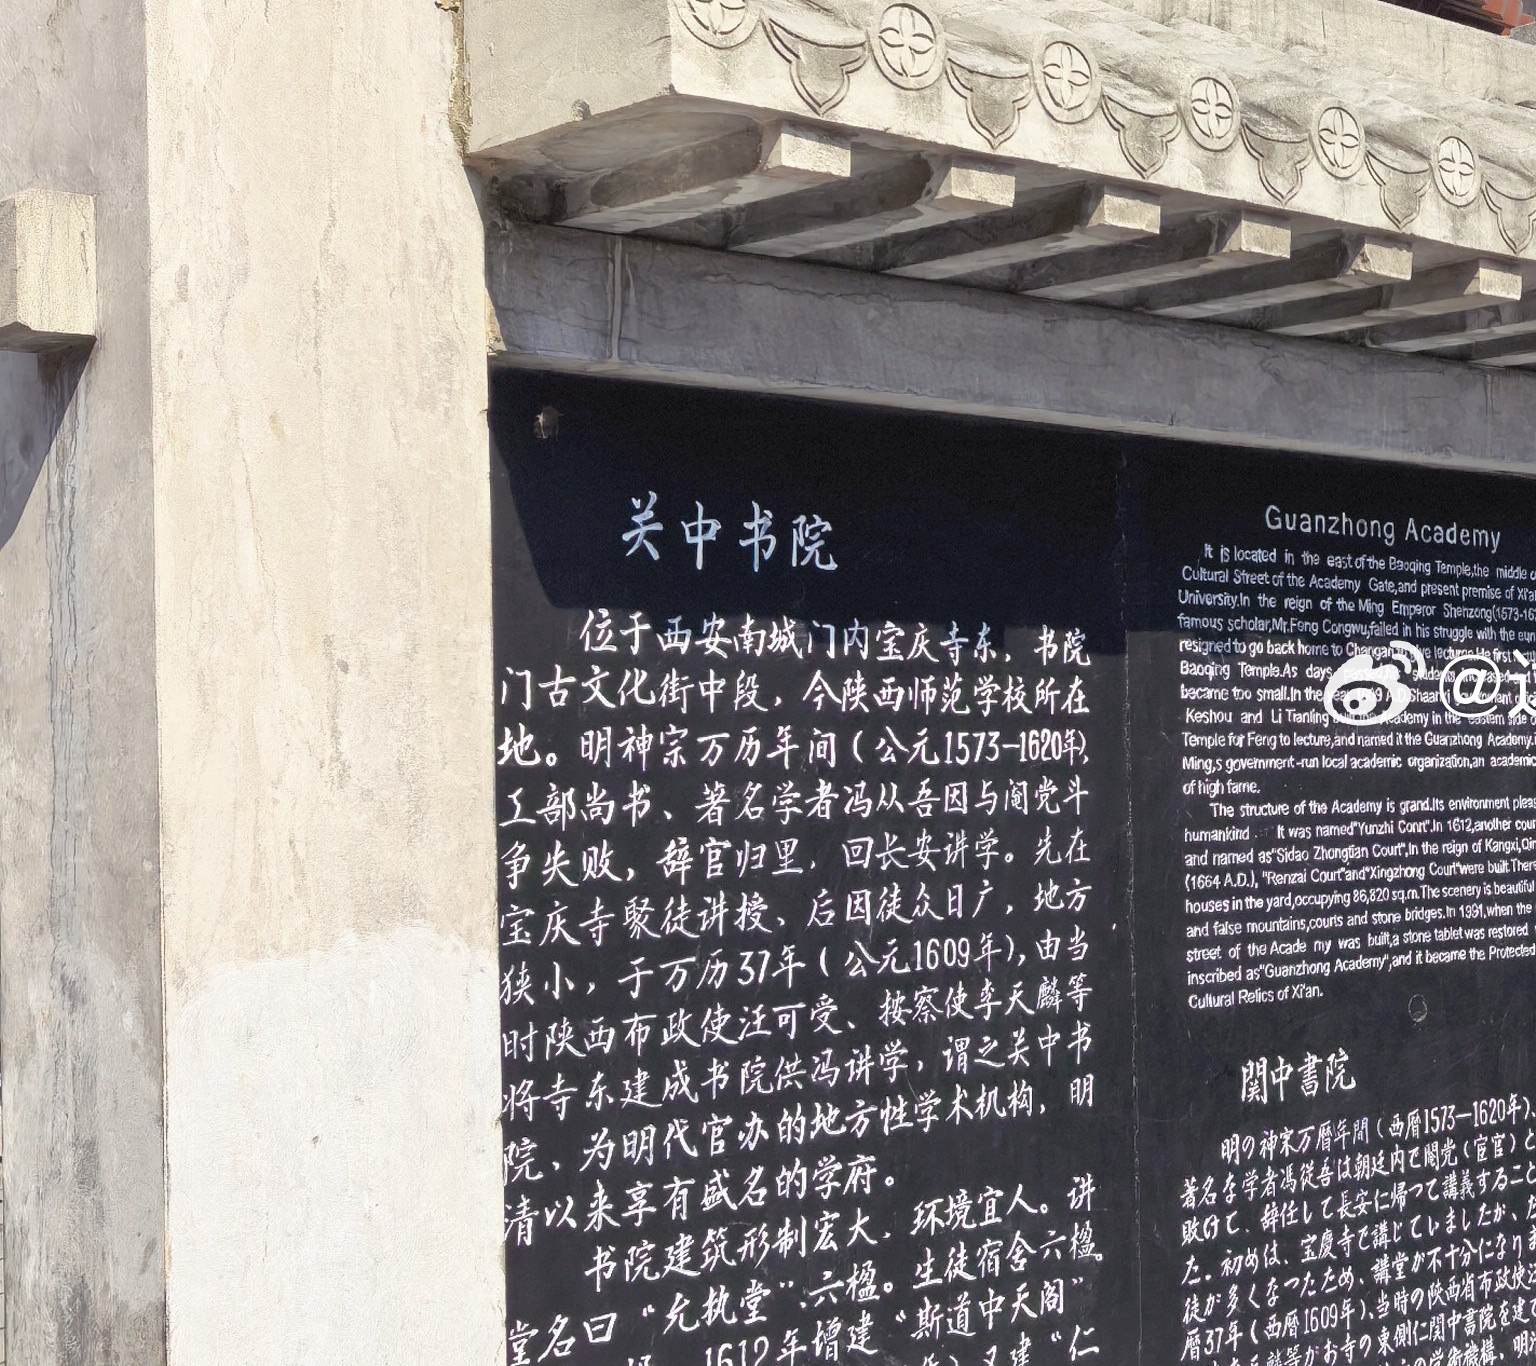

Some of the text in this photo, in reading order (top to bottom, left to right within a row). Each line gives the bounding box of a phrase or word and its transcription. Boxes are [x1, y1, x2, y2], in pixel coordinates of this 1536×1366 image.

[622, 491, 838, 572] 关中书院
[1266, 506, 1500, 553] Guanzhong Academy
[1235, 546, 1276, 562] located
[1497, 566, 1527, 579] middle
[1183, 566, 1228, 582] Cultural
[1309, 575, 1360, 593] Academy
[1421, 583, 1459, 597] present
[1462, 585, 1501, 601] premise
[1284, 598, 1312, 612] reign
[1359, 599, 1384, 617] Ming
[1392, 600, 1436, 619] Emperor
[1177, 613, 1223, 631] famous
[1434, 626, 1473, 642] struggle
[1476, 626, 1496, 640] with
[1180, 638, 1230, 655] resigned
[1267, 640, 1295, 654] back
[1186, 708, 1262, 724] Keshou and
[1182, 732, 1225, 749] Temple
[1248, 732, 1276, 750] Feng
[1358, 732, 1393, 747] named
[1425, 731, 1482, 749] Guanzhong
[1322, 754, 1347, 768] local
[1350, 753, 1402, 768] academic
[1491, 753, 1536, 766] academic
[1210, 803, 1234, 817] The
[1240, 803, 1289, 817] structure
[1332, 800, 1382, 815] Academy
[1449, 797, 1510, 810] environment
[1185, 826, 1249, 842] humankind
[1289, 827, 1311, 839] was
[1185, 850, 1208, 866] and
[1213, 848, 1253, 865] named
[1442, 840, 1468, 857] reign
[1186, 900, 1229, 913] houses
[1442, 886, 1481, 898] scenery
[1494, 880, 1534, 895] beautiful
[1187, 922, 1209, 937] and
[1213, 921, 1241, 935] false
[1347, 911, 1368, 926] and
[1372, 912, 1401, 925] stone
[1186, 946, 1221, 962] street
[1338, 938, 1360, 949] was
[1403, 930, 1431, 943] stone
[1434, 927, 1463, 941] tablet
[1465, 928, 1484, 940] was
[1488, 923, 1528, 939] restored
[1188, 966, 1241, 985] inscribed
[1426, 950, 1466, 964] became
[1489, 943, 1535, 960] Protected
[1188, 992, 1234, 1009] Cultural
[1239, 988, 1274, 1004] Relics
[1242, 1048, 1356, 1104] 関中書院
